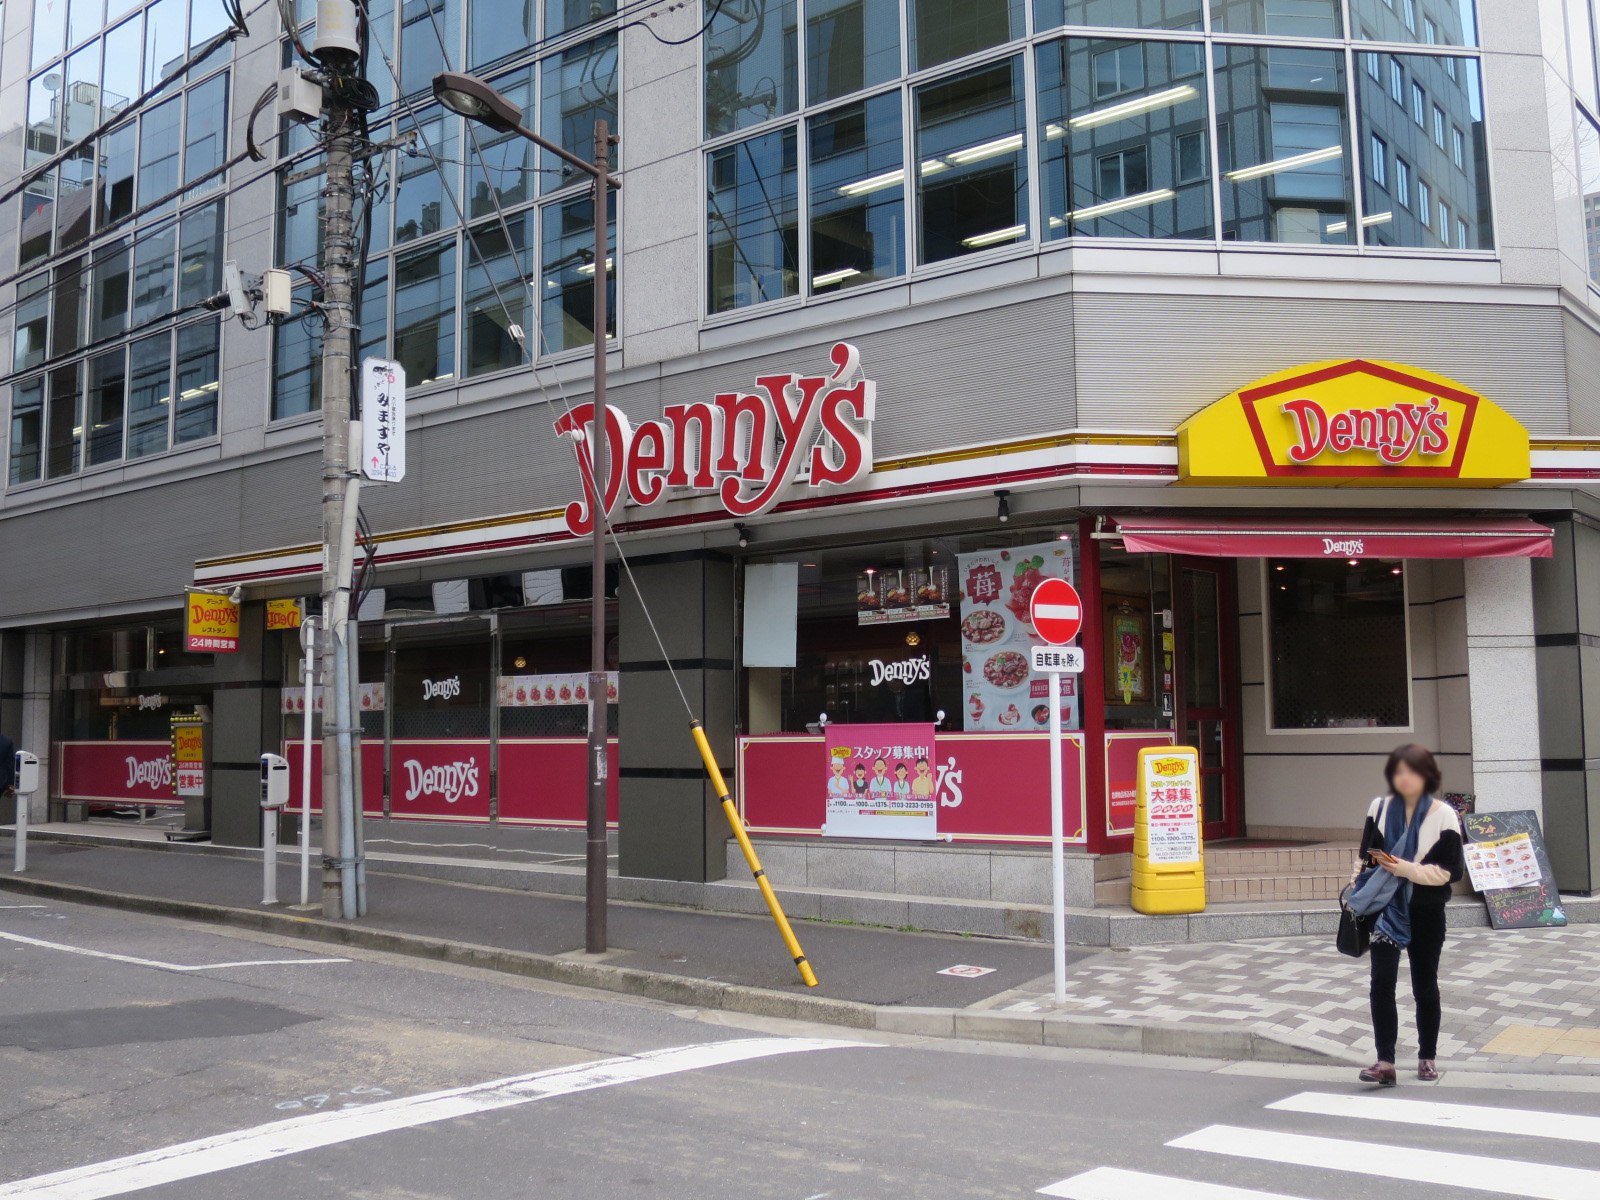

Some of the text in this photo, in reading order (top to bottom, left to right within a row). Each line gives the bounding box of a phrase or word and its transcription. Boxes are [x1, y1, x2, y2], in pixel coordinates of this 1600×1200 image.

[377, 392, 391, 456] みますや
[1281, 396, 1449, 464] Denny's
[552, 341, 877, 537] Denny's
[1322, 538, 1364, 556] Denny's
[973, 571, 996, 597] 苺
[191, 605, 239, 626] Denny's
[201, 626, 227, 634] レストラン
[191, 638, 236, 650] 24時間営業
[1036, 652, 1080, 667] 自転車を除く
[868, 654, 930, 687] Denny's
[422, 675, 460, 700] Denny's
[138, 693, 162, 711] Denny's
[178, 735, 202, 751] Denny's
[853, 745, 929, 760] スタッフ募集中!
[125, 754, 172, 790] Denny's
[1155, 760, 1185, 774] Denny's
[179, 774, 203, 789] 営業中
[403, 756, 479, 803] Denny's
[1151, 788, 1192, 802] 大募集
